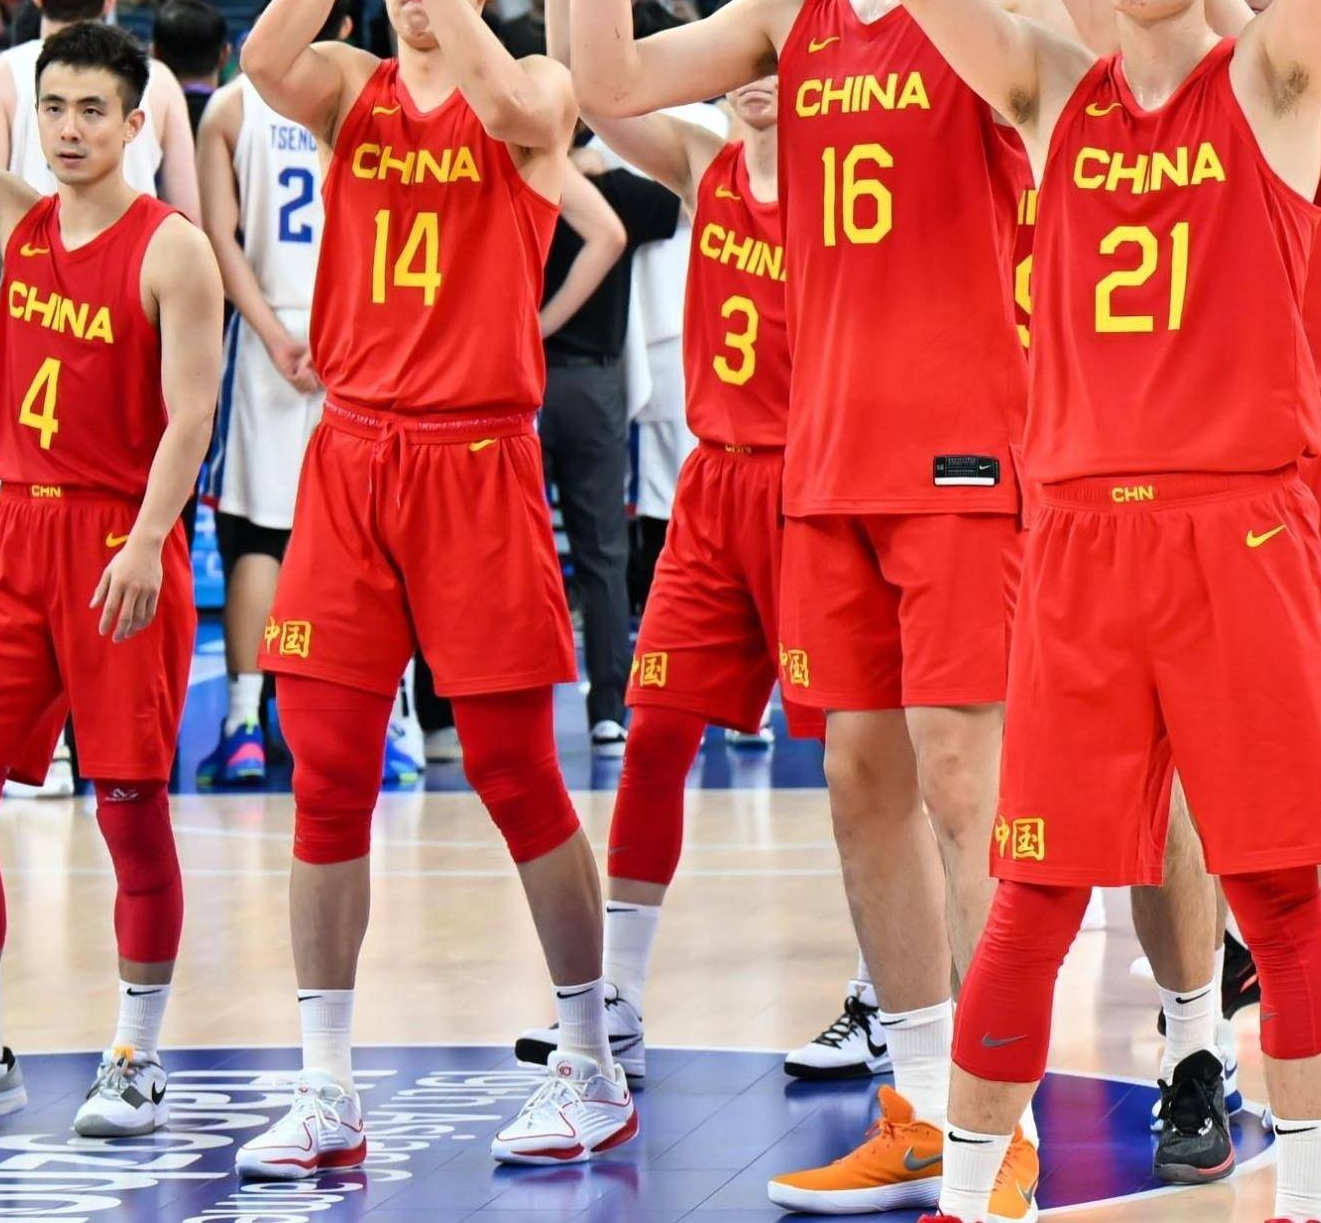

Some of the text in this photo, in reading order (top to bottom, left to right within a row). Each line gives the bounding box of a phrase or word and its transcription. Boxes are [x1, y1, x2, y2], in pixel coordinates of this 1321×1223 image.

[794, 71, 931, 118] CHINA
[351, 142, 481, 185] CHINA
[1073, 141, 1227, 194] CHINA
[278, 167, 315, 244] 2
[822, 142, 894, 247] 16
[371, 209, 442, 306] 14
[699, 223, 787, 282] CHIN
[1094, 221, 1190, 334] 21
[8, 281, 114, 345] CHINA
[712, 295, 759, 386] 3
[18, 356, 62, 450] 4
[31, 484, 62, 498] CHN
[1111, 485, 1154, 503] CHN
[994, 814, 1045, 861] 中国
